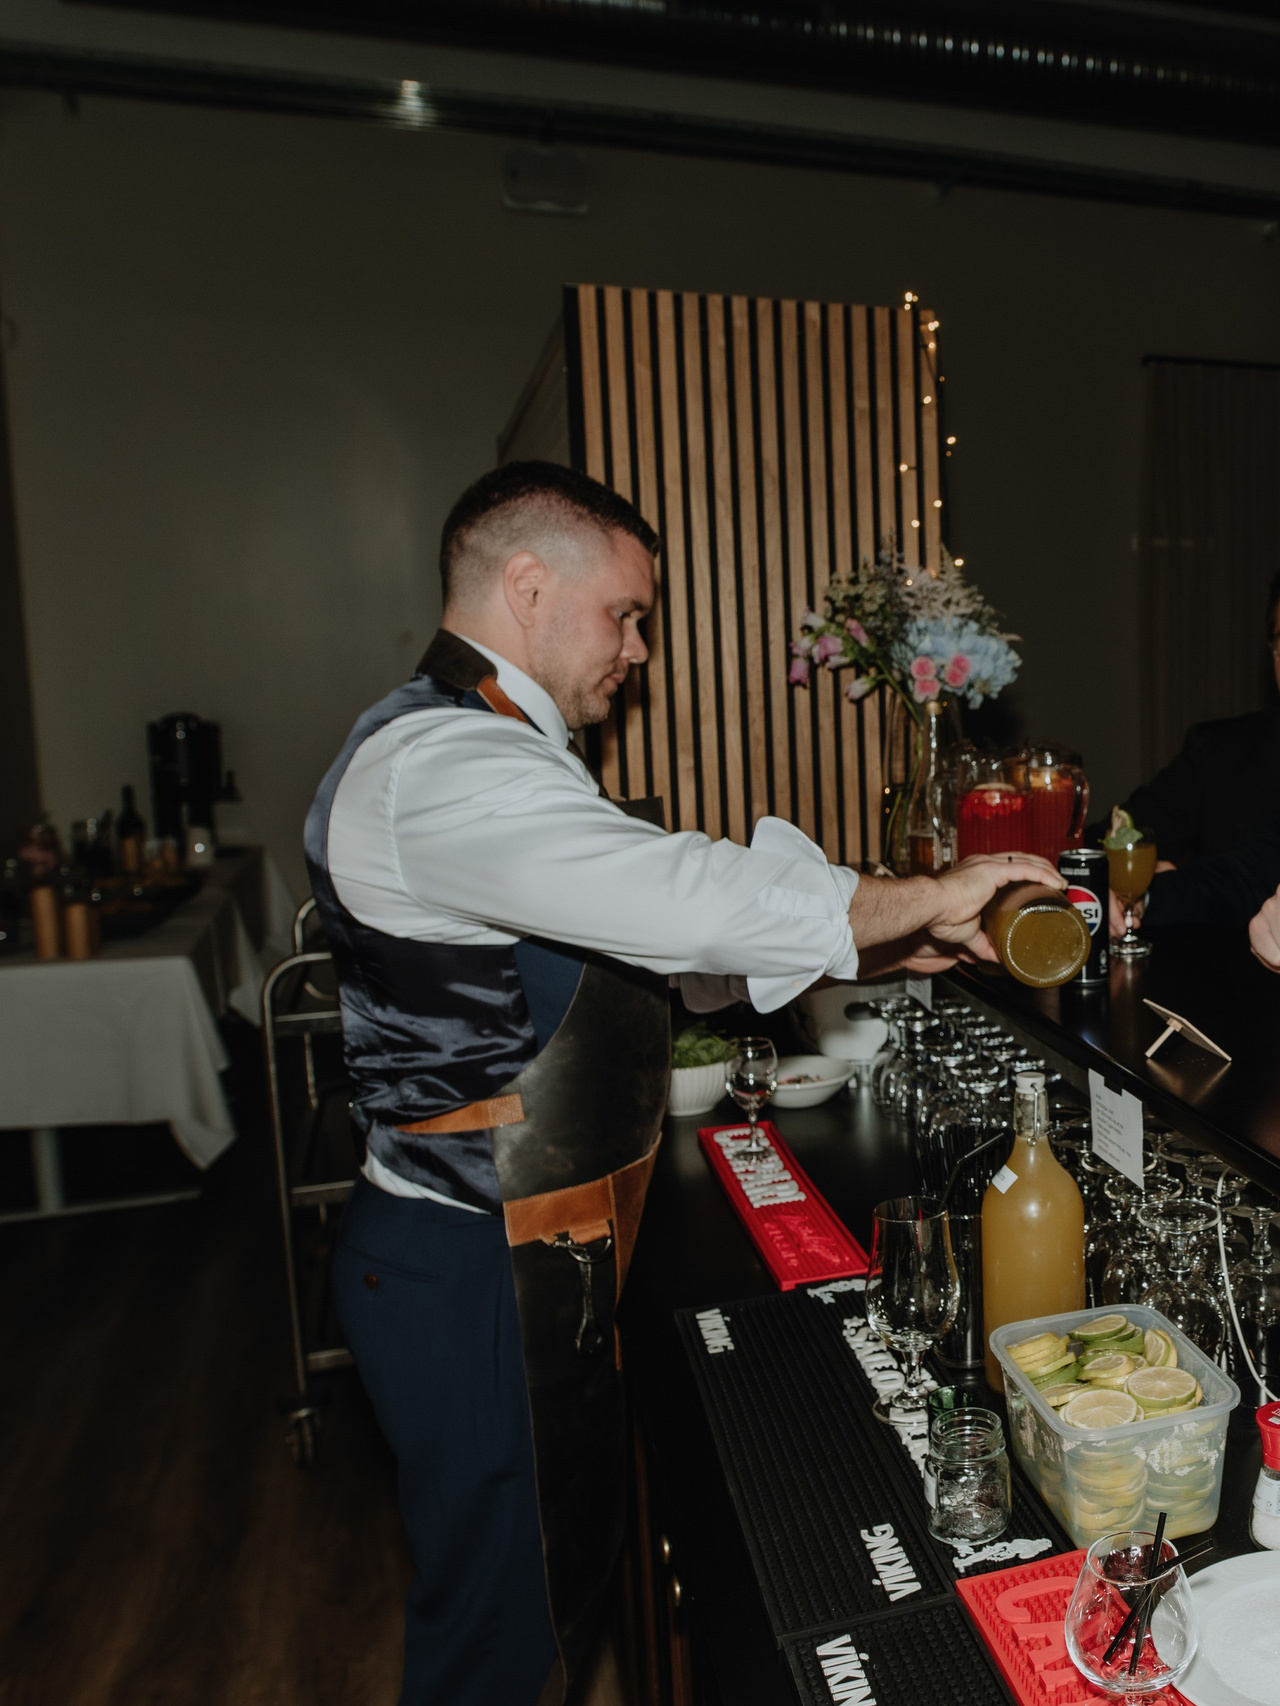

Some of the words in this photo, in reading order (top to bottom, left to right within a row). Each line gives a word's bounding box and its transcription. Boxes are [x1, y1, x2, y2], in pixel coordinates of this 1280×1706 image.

[695, 1307, 735, 1355] VÍKING
[860, 1522, 922, 1602] VÍKING
[816, 1633, 877, 1706] VÍKIN
